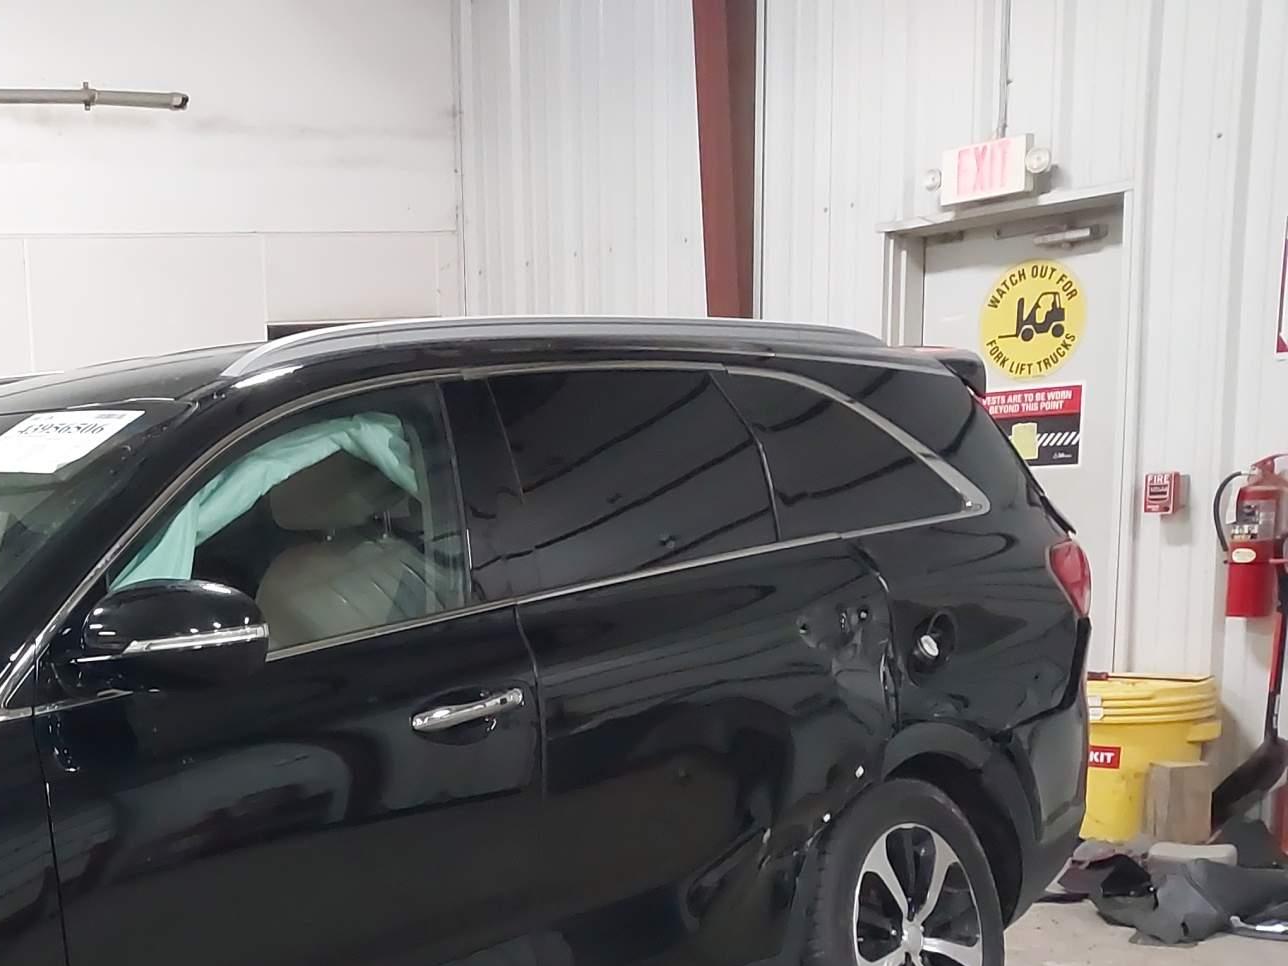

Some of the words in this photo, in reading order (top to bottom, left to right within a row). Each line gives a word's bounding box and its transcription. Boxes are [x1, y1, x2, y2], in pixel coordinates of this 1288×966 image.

[956, 138, 1011, 196] EXIT
[988, 268, 1026, 308] WATCH
[1031, 265, 1057, 280] OUT
[1056, 274, 1078, 301] FOR
[986, 340, 1009, 368] FORK
[1009, 361, 1033, 375] LIFT
[1037, 333, 1076, 372] TRUCKS
[1007, 394, 1021, 404] ARE
[1024, 393, 1034, 403] TO
[1036, 392, 1046, 402] BE
[1047, 390, 1072, 401] WORN
[989, 403, 1019, 414] BEYOND
[1021, 401, 1039, 412] THIS
[1040, 400, 1064, 411] POINT
[1147, 474, 1170, 484] FIRE
[1090, 751, 1115, 763] KIT
